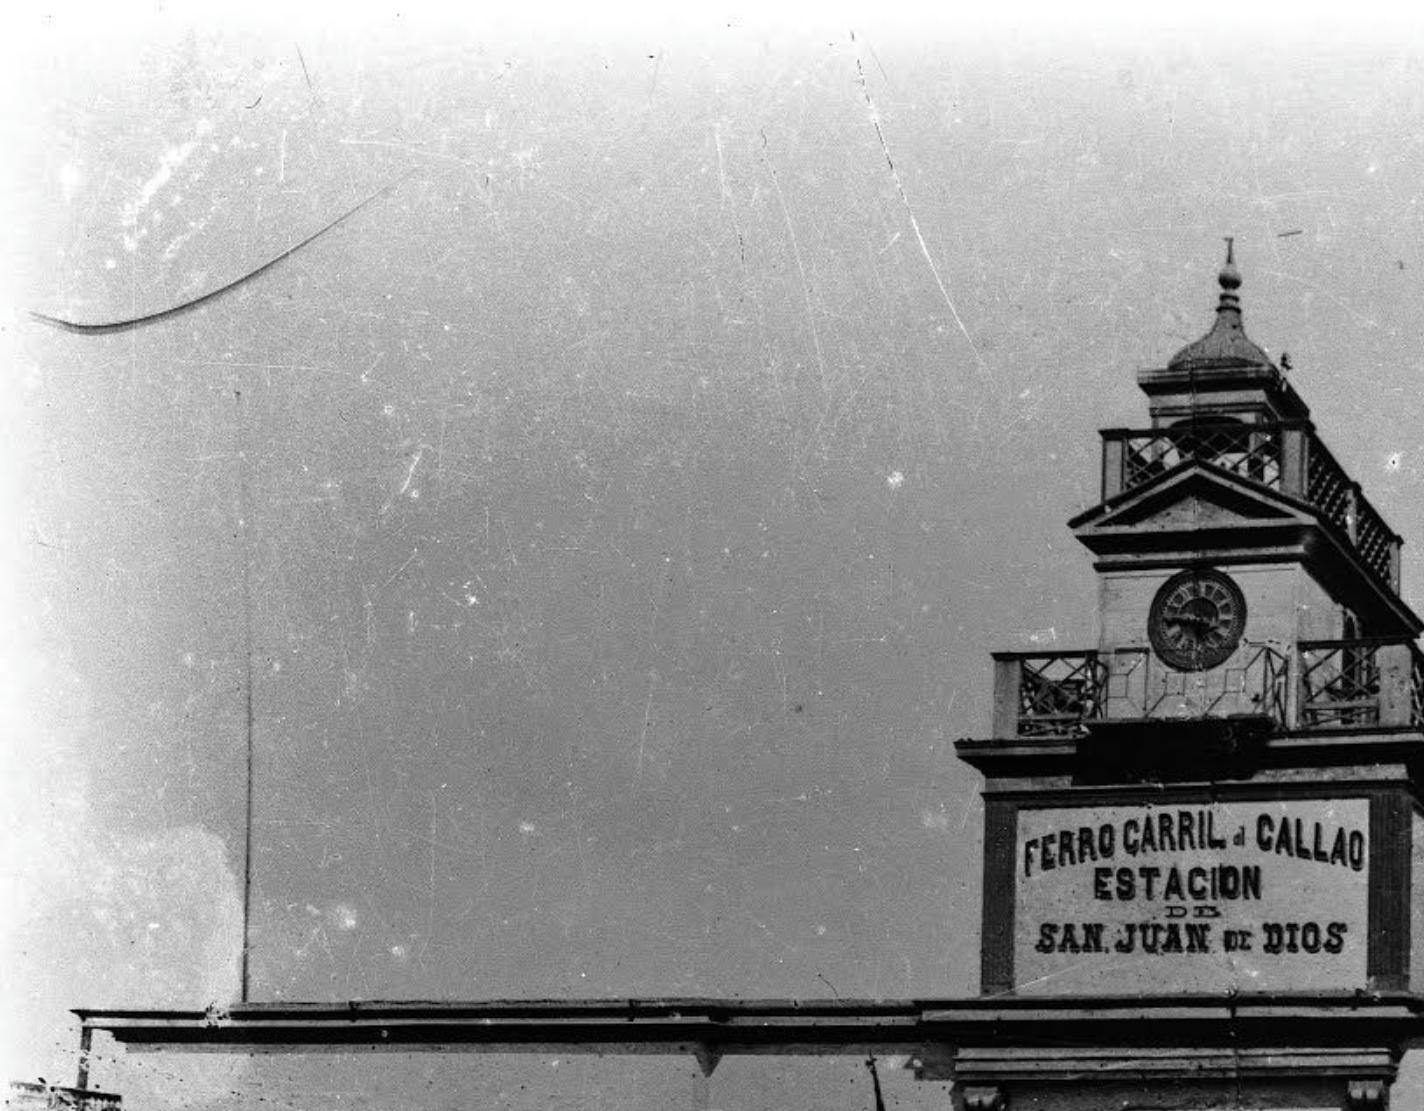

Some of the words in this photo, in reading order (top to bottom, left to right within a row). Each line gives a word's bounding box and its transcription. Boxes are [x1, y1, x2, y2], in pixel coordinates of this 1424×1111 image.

[1025, 823, 1115, 877] FERRO
[1123, 810, 1227, 858] CARRIL
[1256, 813, 1364, 872] CALLAO
[1094, 865, 1262, 901] ESTACION
[1165, 905, 1221, 918] DE
[1115, 922, 1212, 954] JUAN
[1262, 921, 1348, 954] DIOS
